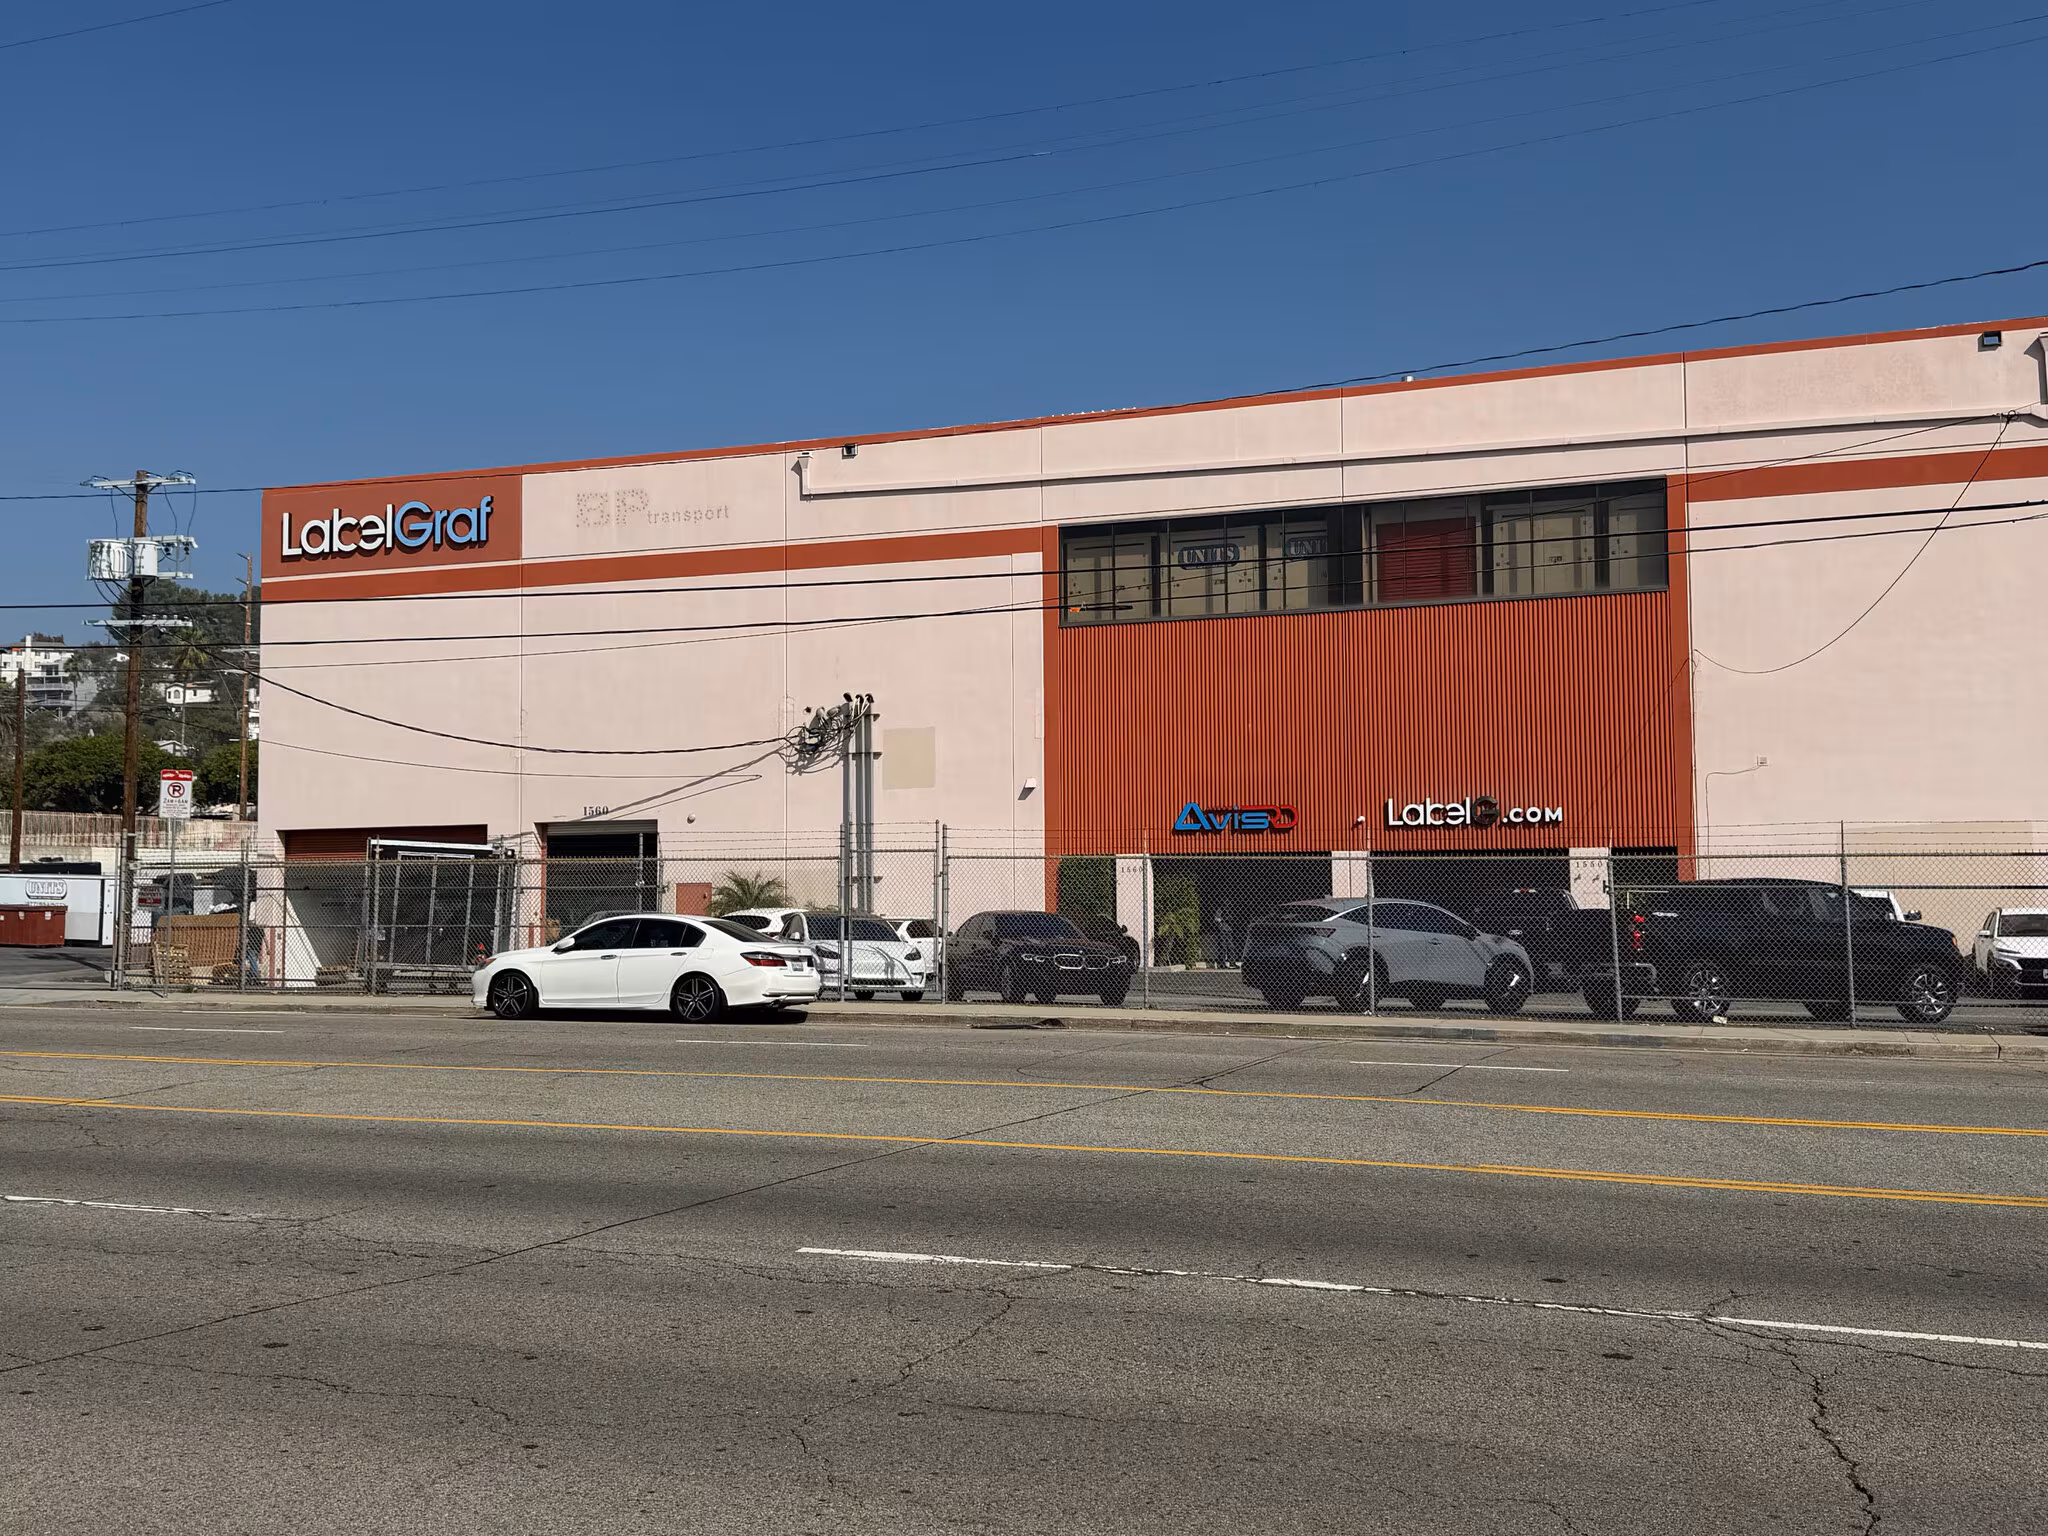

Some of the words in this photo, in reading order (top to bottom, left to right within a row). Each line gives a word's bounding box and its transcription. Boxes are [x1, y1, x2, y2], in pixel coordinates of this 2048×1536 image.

[648, 505, 729, 524] transport
[282, 496, 492, 556] LabelGraf
[1183, 547, 1235, 564] UNITS
[583, 806, 608, 815] 1560
[29, 881, 64, 894] UNITS
